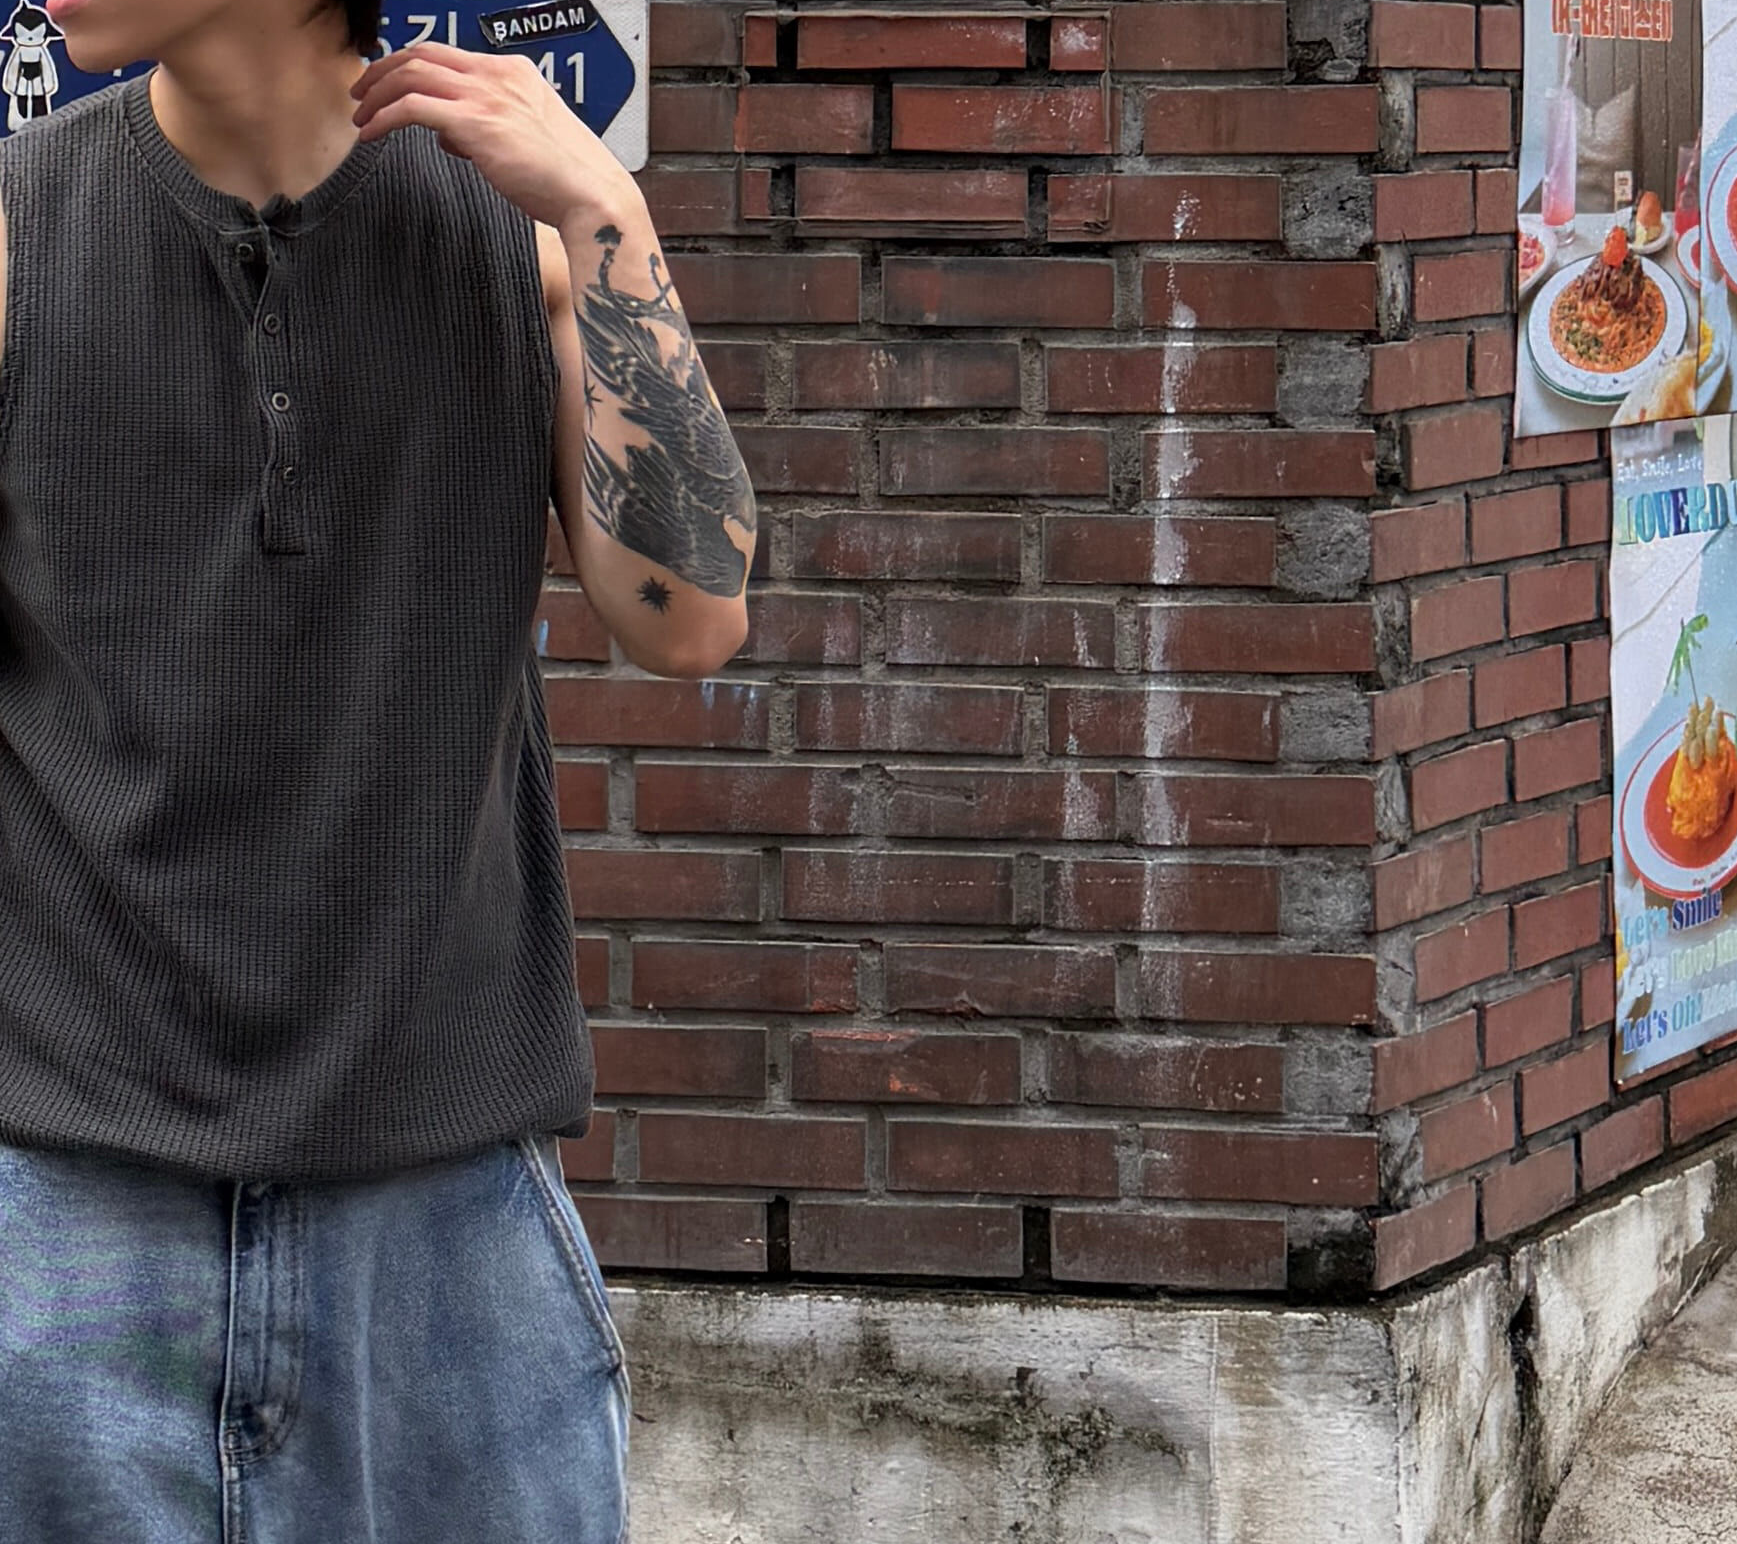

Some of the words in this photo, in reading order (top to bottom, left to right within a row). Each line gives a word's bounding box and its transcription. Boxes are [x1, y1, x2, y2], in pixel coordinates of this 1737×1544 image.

[492, 6, 586, 41] BANDAM
[1672, 886, 1723, 931] Smile
[1623, 1010, 1668, 1054] Let's
